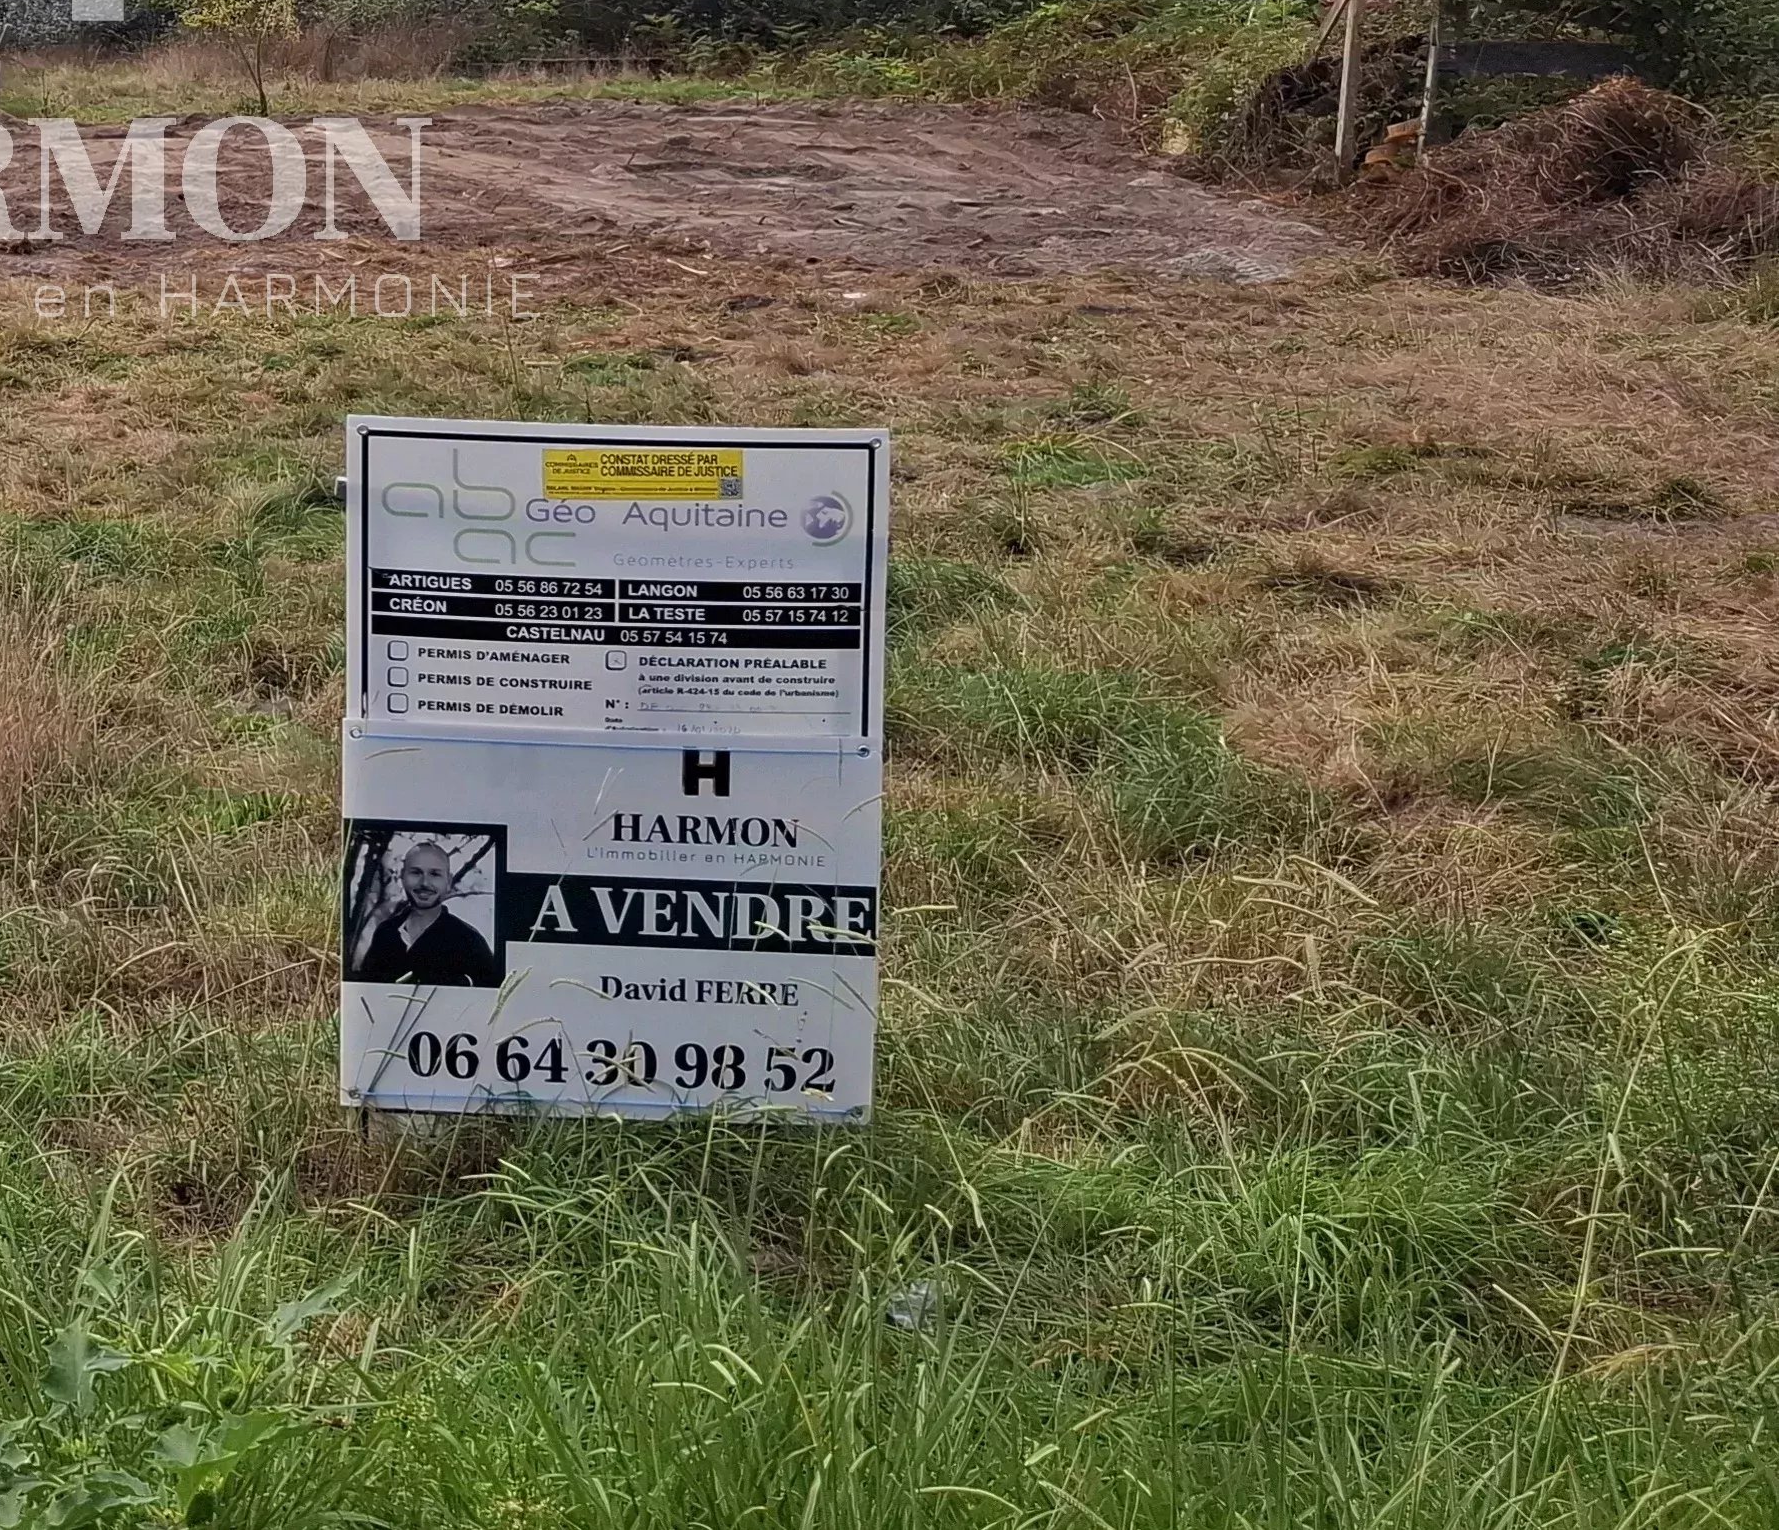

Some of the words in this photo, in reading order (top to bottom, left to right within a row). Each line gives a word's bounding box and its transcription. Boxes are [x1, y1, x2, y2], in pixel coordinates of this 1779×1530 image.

[601, 454, 650, 465] CONSTAT
[652, 452, 695, 465] DRESSÉ
[697, 455, 717, 465] PAR
[601, 466, 674, 476] COMMISSAIRE
[678, 466, 691, 476] DE
[694, 466, 737, 476] JUSTICE
[526, 498, 596, 524] Géo
[622, 502, 788, 532] Aquitaine
[389, 575, 472, 590] ARTIGUES
[495, 580, 513, 592] 05
[517, 580, 535, 593] 56
[540, 581, 558, 593] 86
[563, 582, 580, 594] 72
[584, 582, 602, 595] 54
[628, 584, 697, 598] LANGON
[743, 587, 761, 598] 05
[765, 587, 783, 598] 56
[787, 587, 805, 599] 63
[810, 587, 827, 599] 17
[831, 587, 849, 599] 30
[389, 597, 447, 612] CRÉON
[495, 604, 513, 615] 05
[517, 604, 535, 616] 56
[540, 606, 558, 617] 23
[562, 607, 579, 618] 01
[584, 607, 602, 619] 23
[629, 607, 650, 619] LA
[654, 608, 705, 621] TESTE
[743, 610, 761, 621] 05
[765, 610, 782, 621] 57
[789, 610, 805, 622] 15
[809, 610, 826, 622] 74
[832, 610, 848, 622] 12
[506, 626, 605, 641] CASTELNAU
[620, 630, 639, 642] 05
[643, 631, 660, 642] 57
[665, 631, 682, 643] 54
[689, 632, 706, 644] 15
[710, 632, 727, 644] 74
[418, 648, 471, 660] PERMIS
[639, 655, 739, 668] DÉCLARATION
[744, 657, 826, 669] PRÉALABLE
[418, 673, 471, 685] PERMIS
[476, 677, 494, 686] DE
[500, 678, 593, 690] CONSTRUIRE
[638, 674, 645, 682] à
[674, 674, 718, 683] division
[758, 676, 772, 684] de
[776, 676, 835, 684] construire
[638, 685, 674, 695] (article
[418, 700, 471, 712] PERMIS
[476, 703, 494, 713] DE
[500, 702, 564, 716] DÉMOLIR
[682, 748, 730, 796] H
[611, 813, 799, 848] HARMON
[587, 847, 695, 862] L'immobilier
[705, 853, 725, 863] en
[734, 854, 826, 867] HARMONIE
[530, 885, 577, 932] A
[590, 887, 872, 945] VENDRE
[600, 976, 686, 1002] David
[695, 979, 799, 1006] FERRE
[408, 1031, 479, 1078] 06
[495, 1035, 568, 1083] 64
[585, 1039, 657, 1087] 30
[675, 1043, 746, 1090] 98
[764, 1046, 837, 1093] 52
